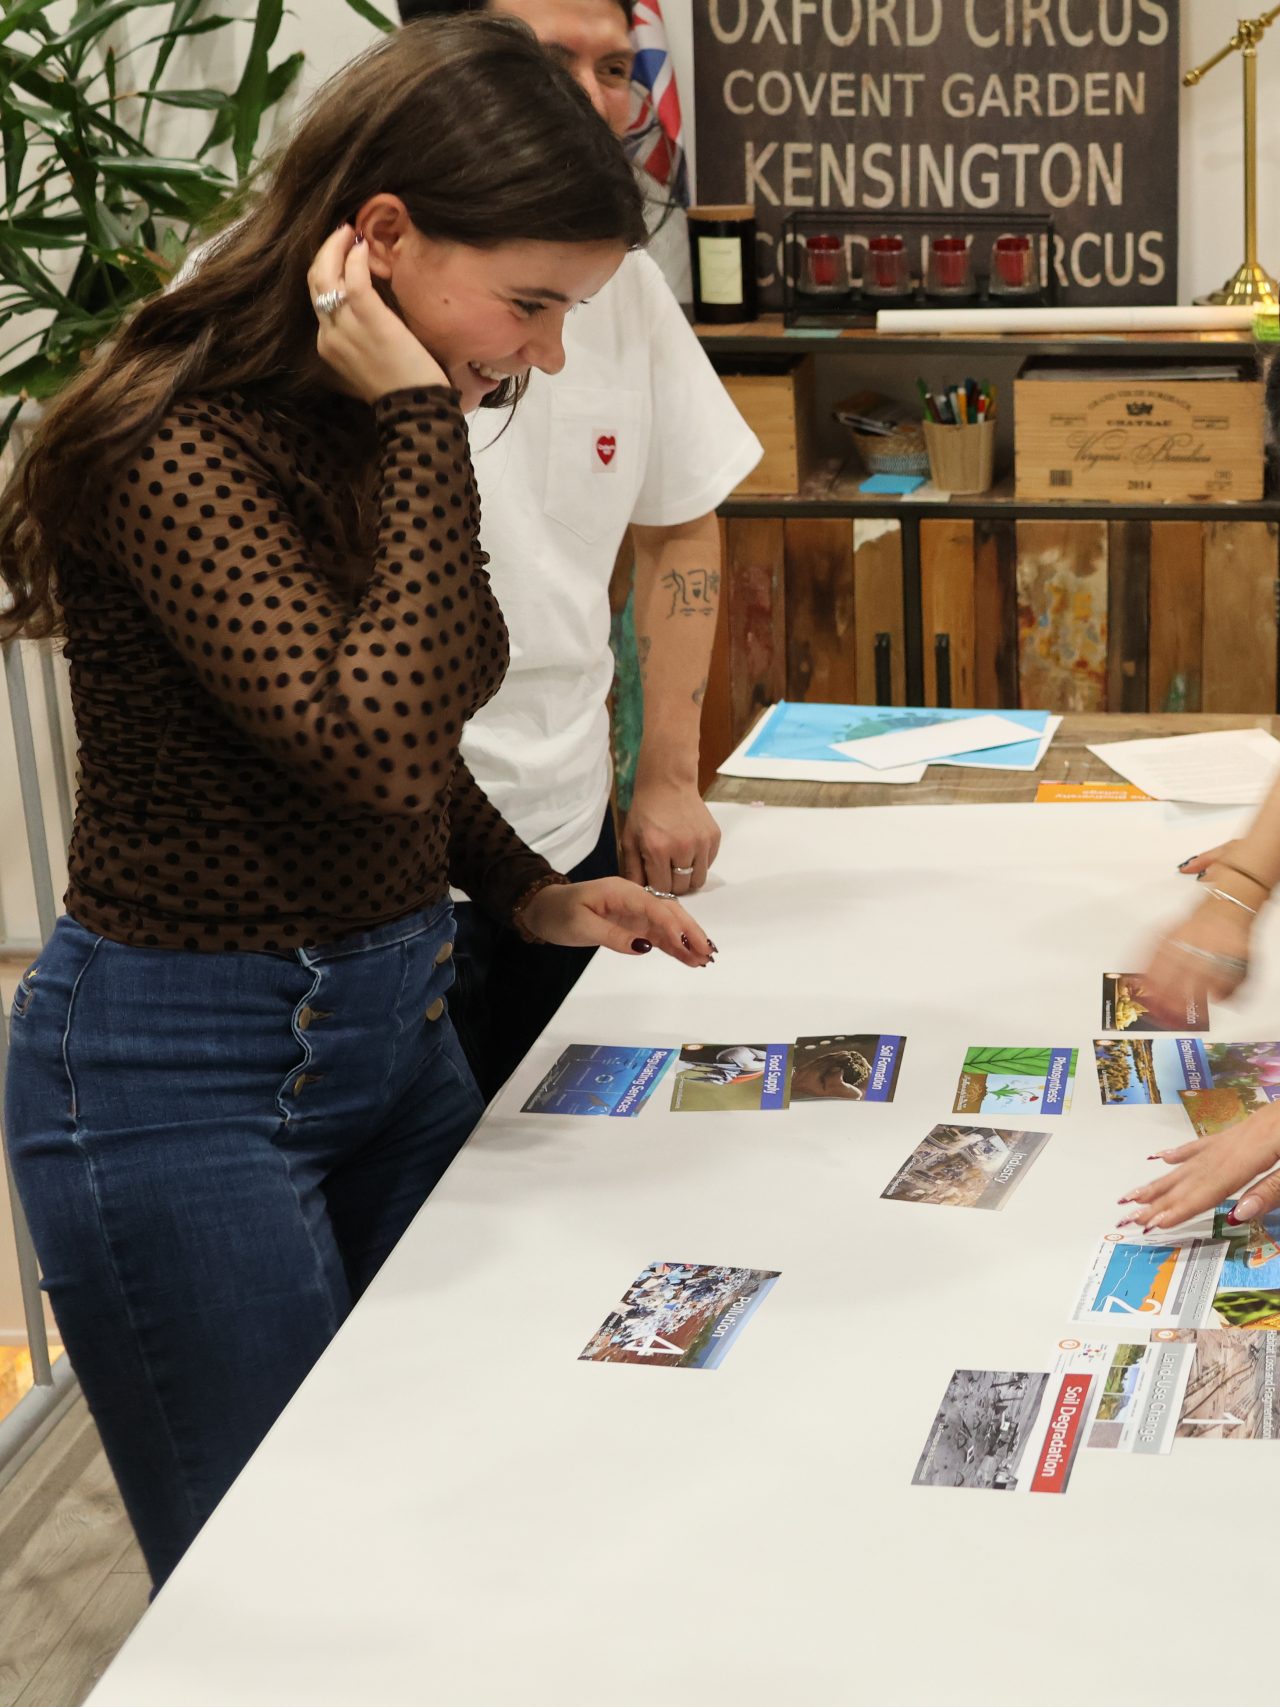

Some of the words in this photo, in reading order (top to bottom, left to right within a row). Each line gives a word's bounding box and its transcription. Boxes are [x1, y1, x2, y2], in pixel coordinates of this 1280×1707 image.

[708, 0, 943, 47] OXFORD
[965, 0, 1169, 48] CIRCUS
[723, 70, 925, 118] COVENT
[942, 71, 1146, 118] GARDEN
[744, 141, 1124, 208] KENSINGTON
[632, 1050, 668, 1086] Regulating
[769, 1054, 783, 1071] Food
[880, 1044, 894, 1058] Soil
[1180, 1039, 1196, 1071] Freshwater
[1189, 1071, 1201, 1090] Filtra
[763, 1071, 781, 1095] Supply
[871, 1057, 892, 1090] Formation
[1046, 1056, 1067, 1104] Photosynthesis
[616, 1085, 645, 1113] Services
[994, 1152, 1028, 1184] Industry
[711, 1296, 752, 1338] Pollution
[1265, 1330, 1278, 1354] Habitat
[1151, 1352, 1179, 1400] Land-Use
[1264, 1354, 1277, 1369] Loss
[1264, 1369, 1276, 1385] and
[1062, 1385, 1083, 1405] Soil
[1261, 1385, 1276, 1440] Fragmentation
[1138, 1401, 1167, 1443] Change
[1041, 1405, 1077, 1478] Degradation
